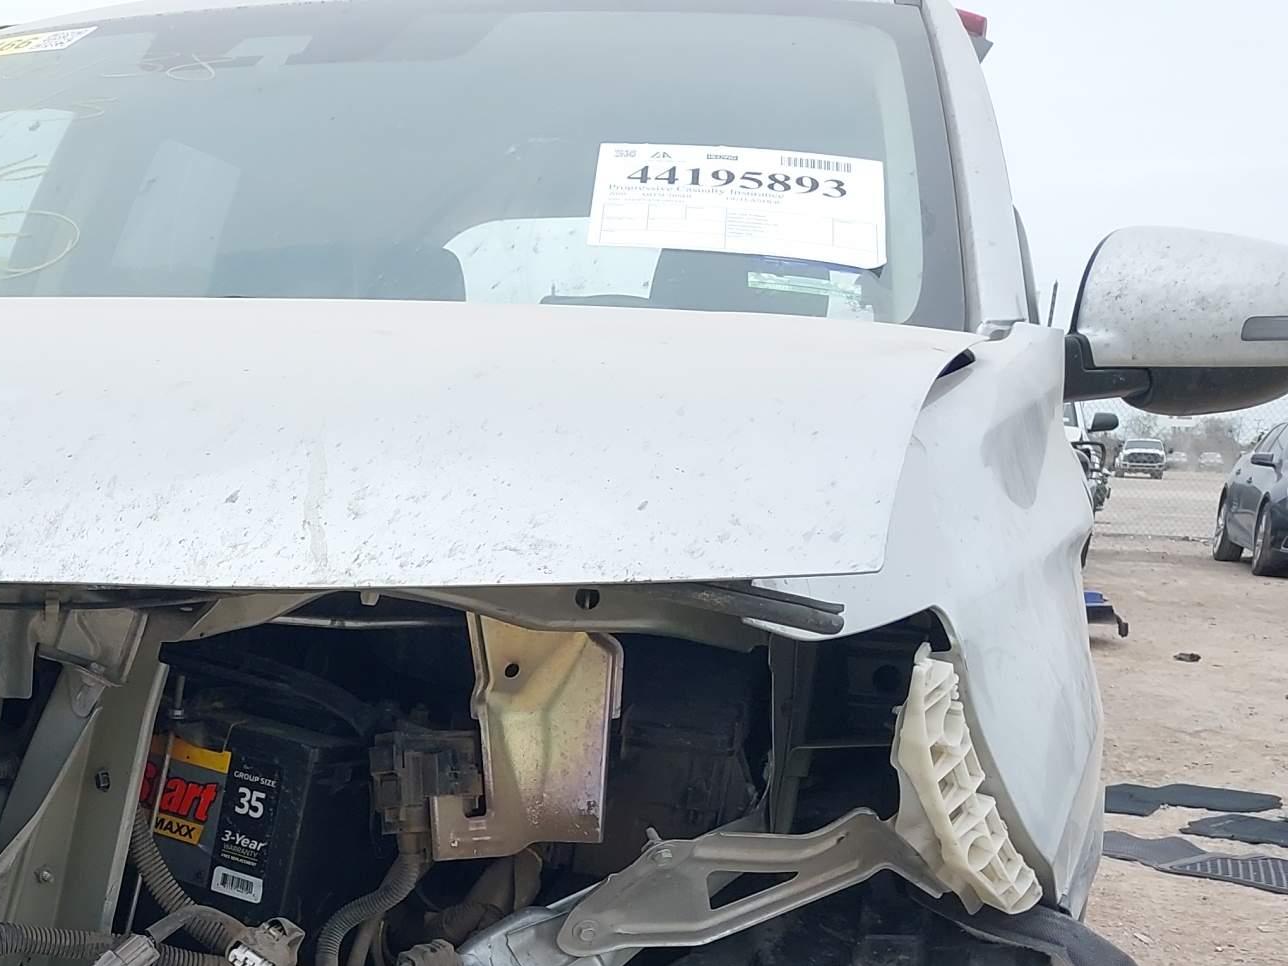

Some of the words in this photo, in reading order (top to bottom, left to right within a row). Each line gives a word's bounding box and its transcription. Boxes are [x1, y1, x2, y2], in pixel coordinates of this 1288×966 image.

[626, 165, 847, 199] 44195893
[233, 770, 259, 782] GROUP
[260, 777, 277, 788] SIZE
[234, 786, 266, 818] 35
[220, 829, 268, 851] 3-Year
